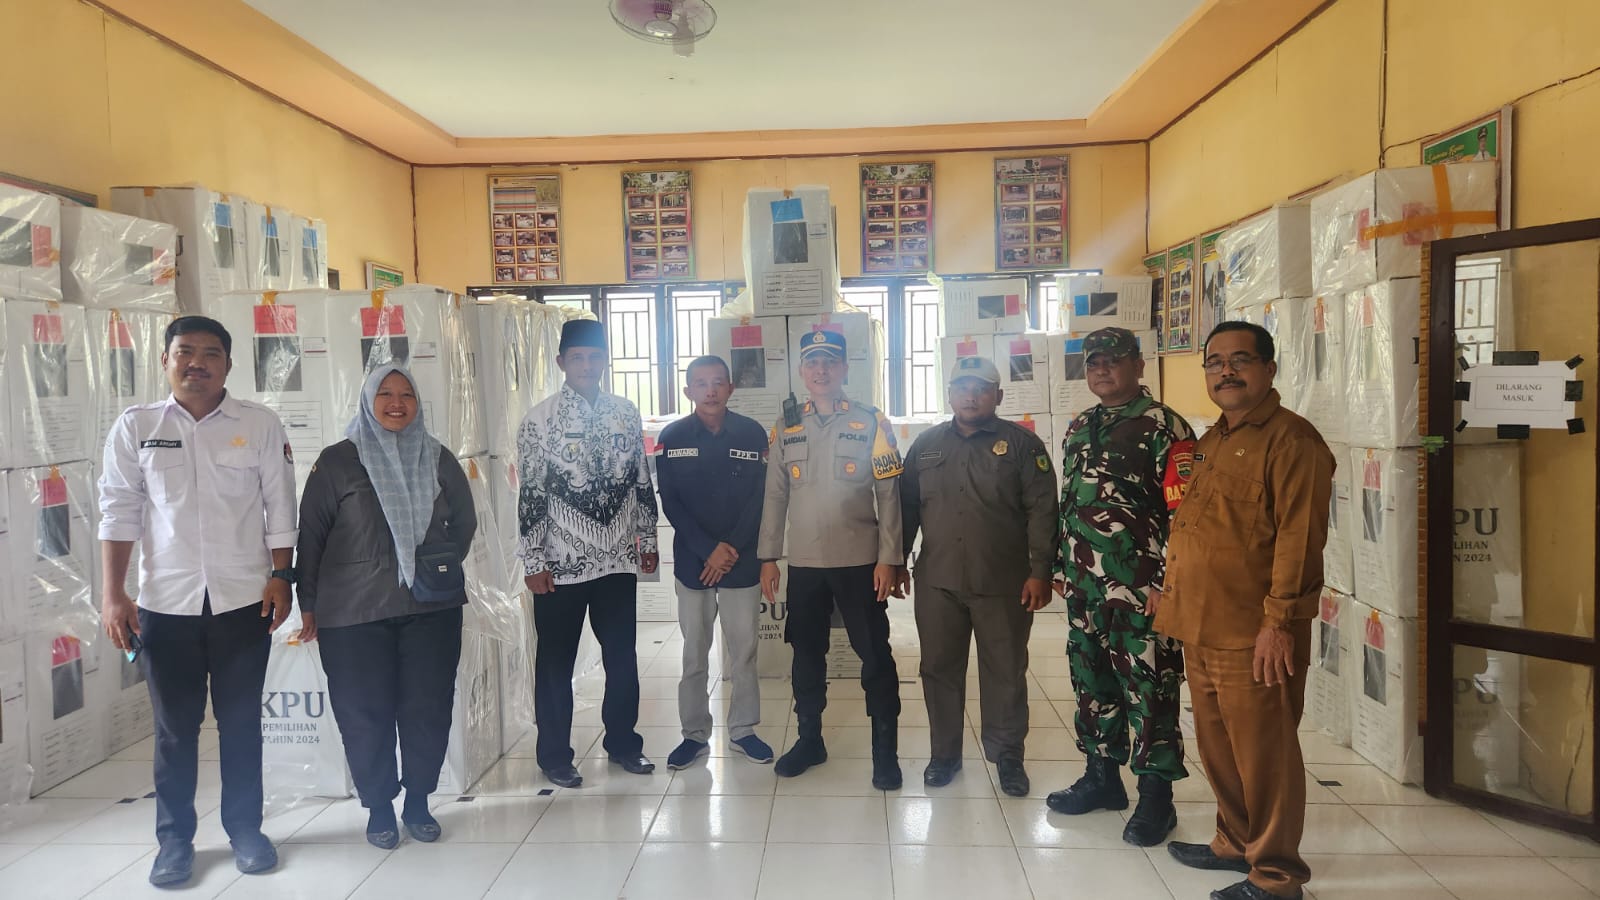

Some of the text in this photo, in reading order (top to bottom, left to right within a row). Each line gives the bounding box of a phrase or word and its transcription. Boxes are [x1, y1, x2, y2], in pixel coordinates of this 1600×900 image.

[1496, 383, 1542, 391] DILARANG
[1502, 394, 1534, 402] MASUK
[838, 432, 868, 442] POLRI
[736, 450, 753, 459] PPK
[1453, 507, 1499, 535] PU
[1454, 541, 1488, 550] LIHAN
[1464, 553, 1491, 562] 2024
[760, 602, 787, 621] PU
[261, 691, 325, 718] KPU
[263, 723, 317, 732] PEMILIHAN
[296, 735, 321, 744] 2024
